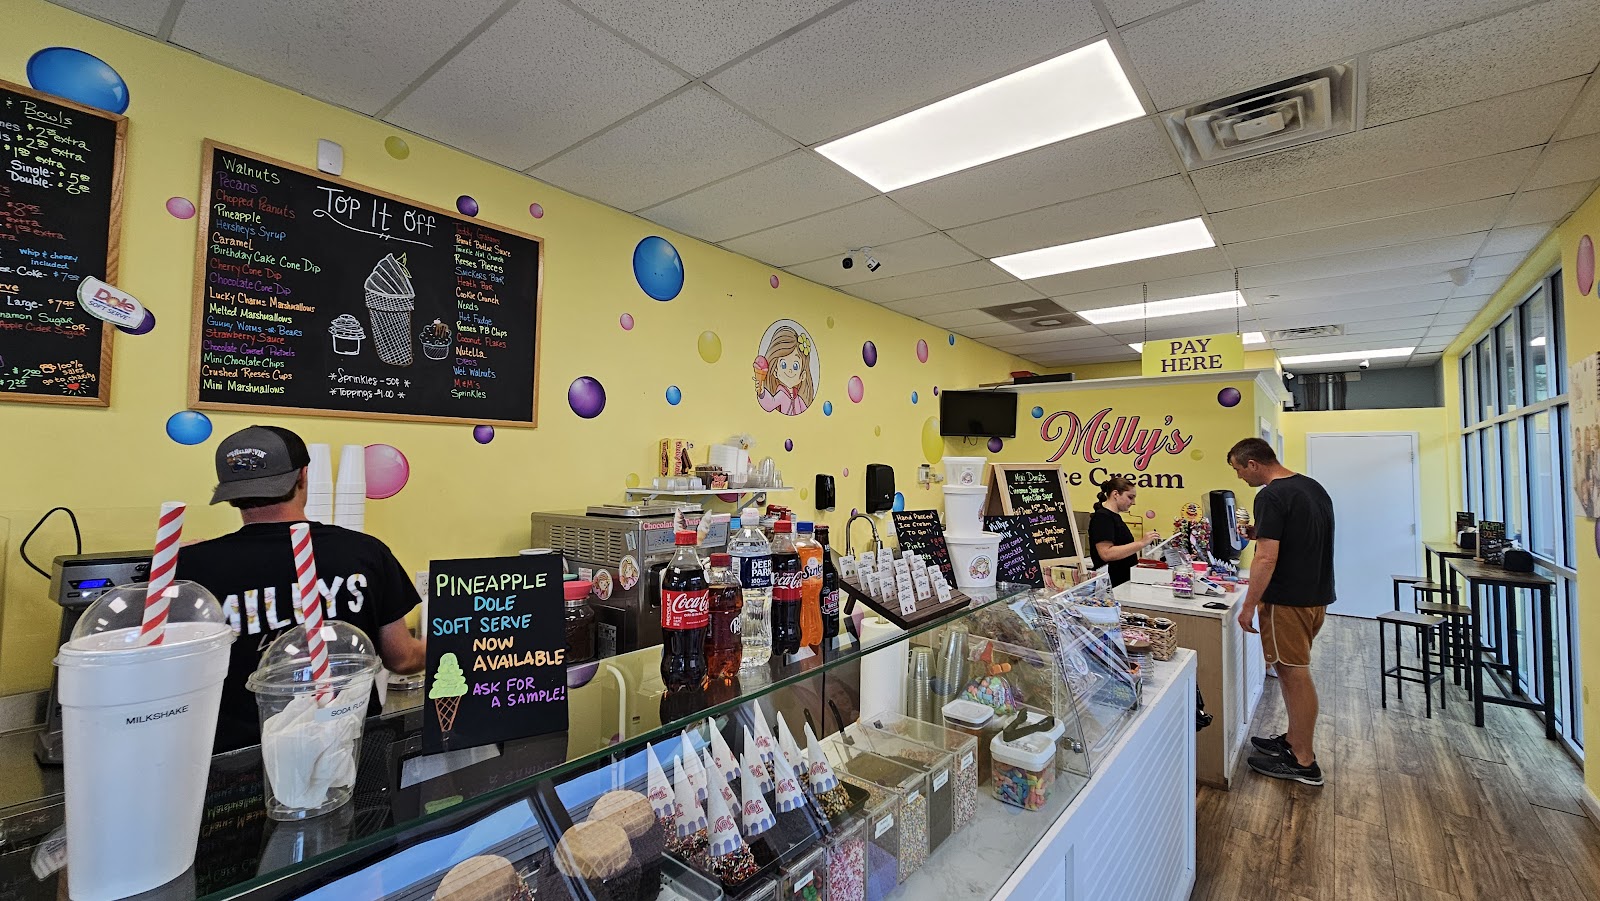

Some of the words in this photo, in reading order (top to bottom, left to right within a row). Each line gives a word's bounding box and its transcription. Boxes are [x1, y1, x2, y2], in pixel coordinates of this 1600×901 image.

[21, 101, 73, 125] Bowls
[0, 120, 20, 131] nes
[54, 134, 91, 151] extra
[35, 156, 66, 170] extra
[51, 147, 85, 163] extra
[223, 156, 280, 184] Walnuts
[216, 171, 258, 193] Pecans
[216, 189, 253, 207] Chopped
[259, 196, 295, 218] Peanuts
[317, 186, 360, 219] Top
[372, 199, 393, 231] It
[404, 210, 436, 235] Off
[214, 203, 261, 223] Pineapple
[6, 217, 42, 228] extra
[216, 219, 256, 239] Hershey's
[258, 226, 286, 241] Syrup
[33, 229, 66, 241] extra
[212, 232, 253, 250] Caramel
[30, 258, 70, 270] included
[210, 244, 252, 264] Birthday
[254, 251, 275, 264] Cake
[280, 256, 301, 270] Cone
[301, 258, 321, 273] Dip
[478, 259, 504, 274] Pieces
[210, 258, 240, 277] Cherry
[242, 264, 262, 276] Cone
[264, 268, 282, 280] Dip
[209, 272, 254, 289] Chocolate
[254, 281, 273, 292] Cone
[273, 283, 291, 296] Dip
[457, 276, 476, 288] Heath
[480, 281, 494, 291] Bar
[489, 273, 504, 285] Bar
[94, 287, 136, 313] Dole
[210, 286, 235, 305] Lucky
[238, 293, 267, 306] Charms
[270, 297, 315, 312] Marshmallows
[456, 287, 475, 300] Cookie
[477, 292, 500, 305] Crunch
[88, 300, 107, 311] SOFT
[107, 308, 130, 320] SERVE
[209, 303, 237, 316] Melted
[240, 309, 292, 324] Marshmallows
[457, 300, 479, 311] Nerds
[0, 312, 33, 320] namon
[38, 313, 74, 327] Sugar
[26, 322, 52, 333] Cider
[207, 316, 233, 332] Gummy
[237, 321, 262, 333] Worms
[277, 325, 303, 337] Bears
[459, 312, 471, 322] Hot
[473, 314, 493, 327] Fudge
[206, 329, 256, 345] Strawberry
[257, 333, 285, 344] Sauce
[479, 326, 490, 334] PB
[203, 340, 237, 353] Chocolate
[457, 333, 482, 345] Coconut
[485, 337, 507, 348] Flakes
[1170, 338, 1212, 356] PAY
[203, 352, 222, 363] Mini
[224, 355, 261, 366] Chocolate
[262, 358, 285, 368] Chips
[456, 345, 487, 358] Nutella
[202, 365, 238, 377] Crushed
[241, 367, 270, 379] Reese's
[272, 369, 292, 380] Cups
[453, 366, 467, 376] Wet
[469, 368, 496, 378] Walnuts
[1161, 354, 1223, 373] HERE
[338, 368, 378, 386] Sprinkles
[203, 379, 223, 390] Mini
[228, 380, 285, 394] Marshmallows
[335, 387, 372, 401] Toppings
[451, 389, 486, 399] Sprinkles
[1040, 408, 1192, 471] Milly's
[1089, 467, 1184, 489] Cream
[904, 541, 925, 549] Pints
[752, 559, 772, 568] DEER
[436, 573, 548, 597] PINEAPPLE
[474, 595, 517, 611] DOLE
[432, 616, 472, 636] SOFT
[480, 614, 532, 633] SERVE
[473, 636, 514, 651] NOW
[473, 649, 565, 671] AVAILABLE
[473, 681, 500, 695] ASK
[507, 677, 535, 691] FOR
[491, 696, 500, 708] A
[507, 686, 565, 707] SAMPLE!
[126, 705, 189, 725] MILKSHAKE
[331, 707, 351, 717] SODA
